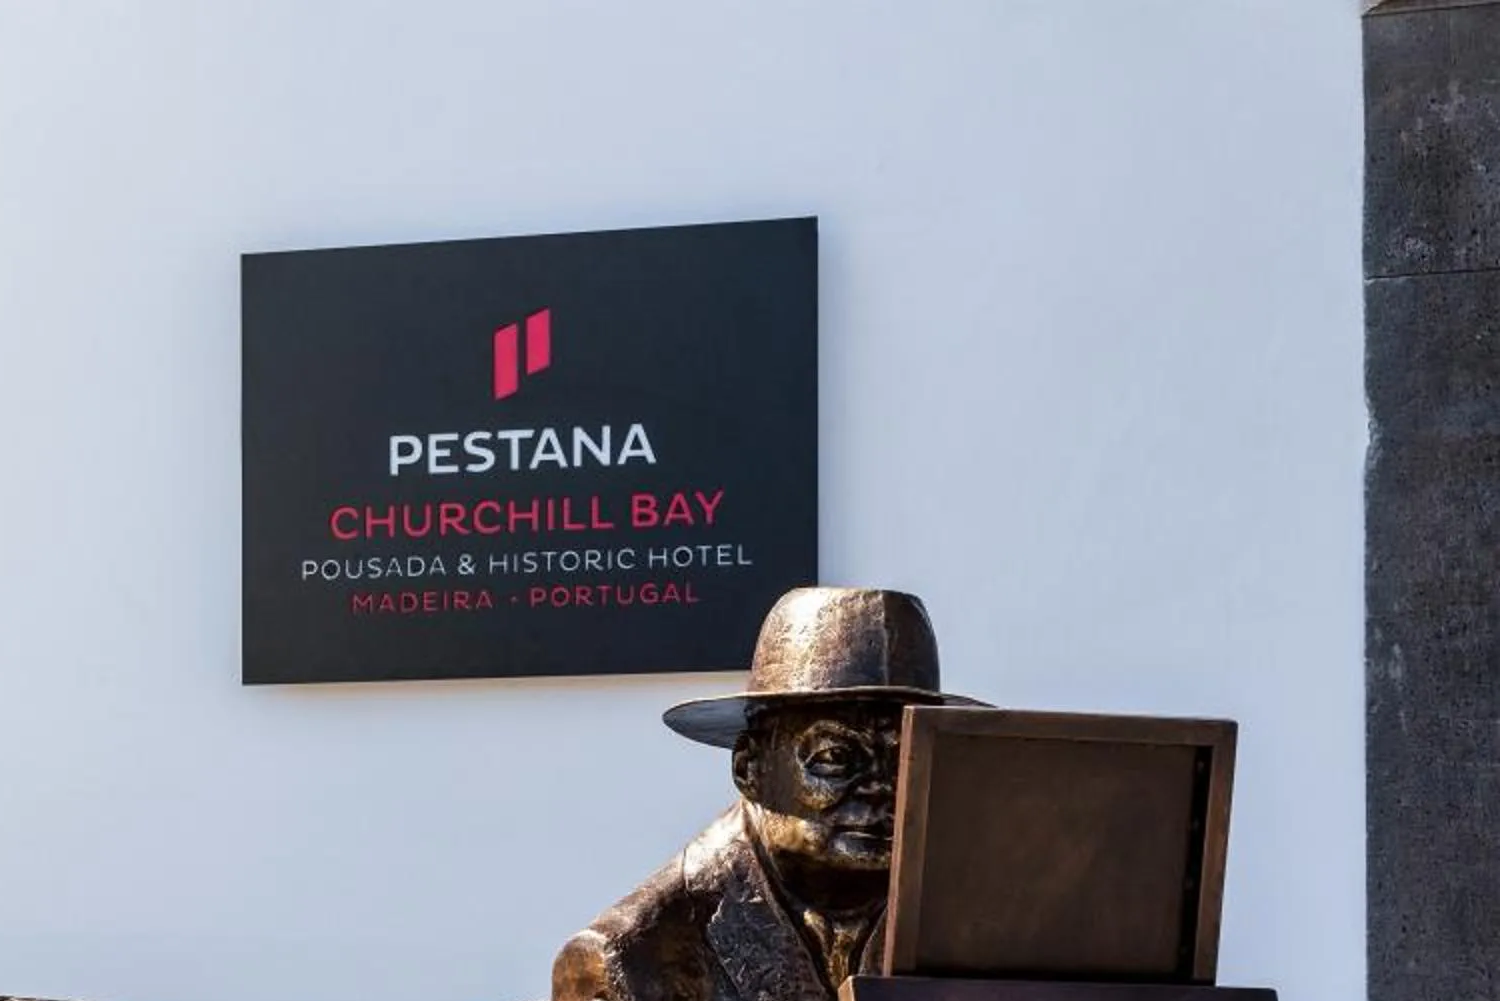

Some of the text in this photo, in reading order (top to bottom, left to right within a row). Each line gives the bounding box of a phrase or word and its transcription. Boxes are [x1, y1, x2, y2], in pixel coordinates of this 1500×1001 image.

[389, 423, 657, 476] PESTANA
[330, 491, 724, 541] CHURCHILL BAY
[301, 543, 753, 581] POUSADA & HISTORIC HOTEL
[352, 590, 494, 613] MADEIRA
[529, 582, 699, 608] PORTUGAL
